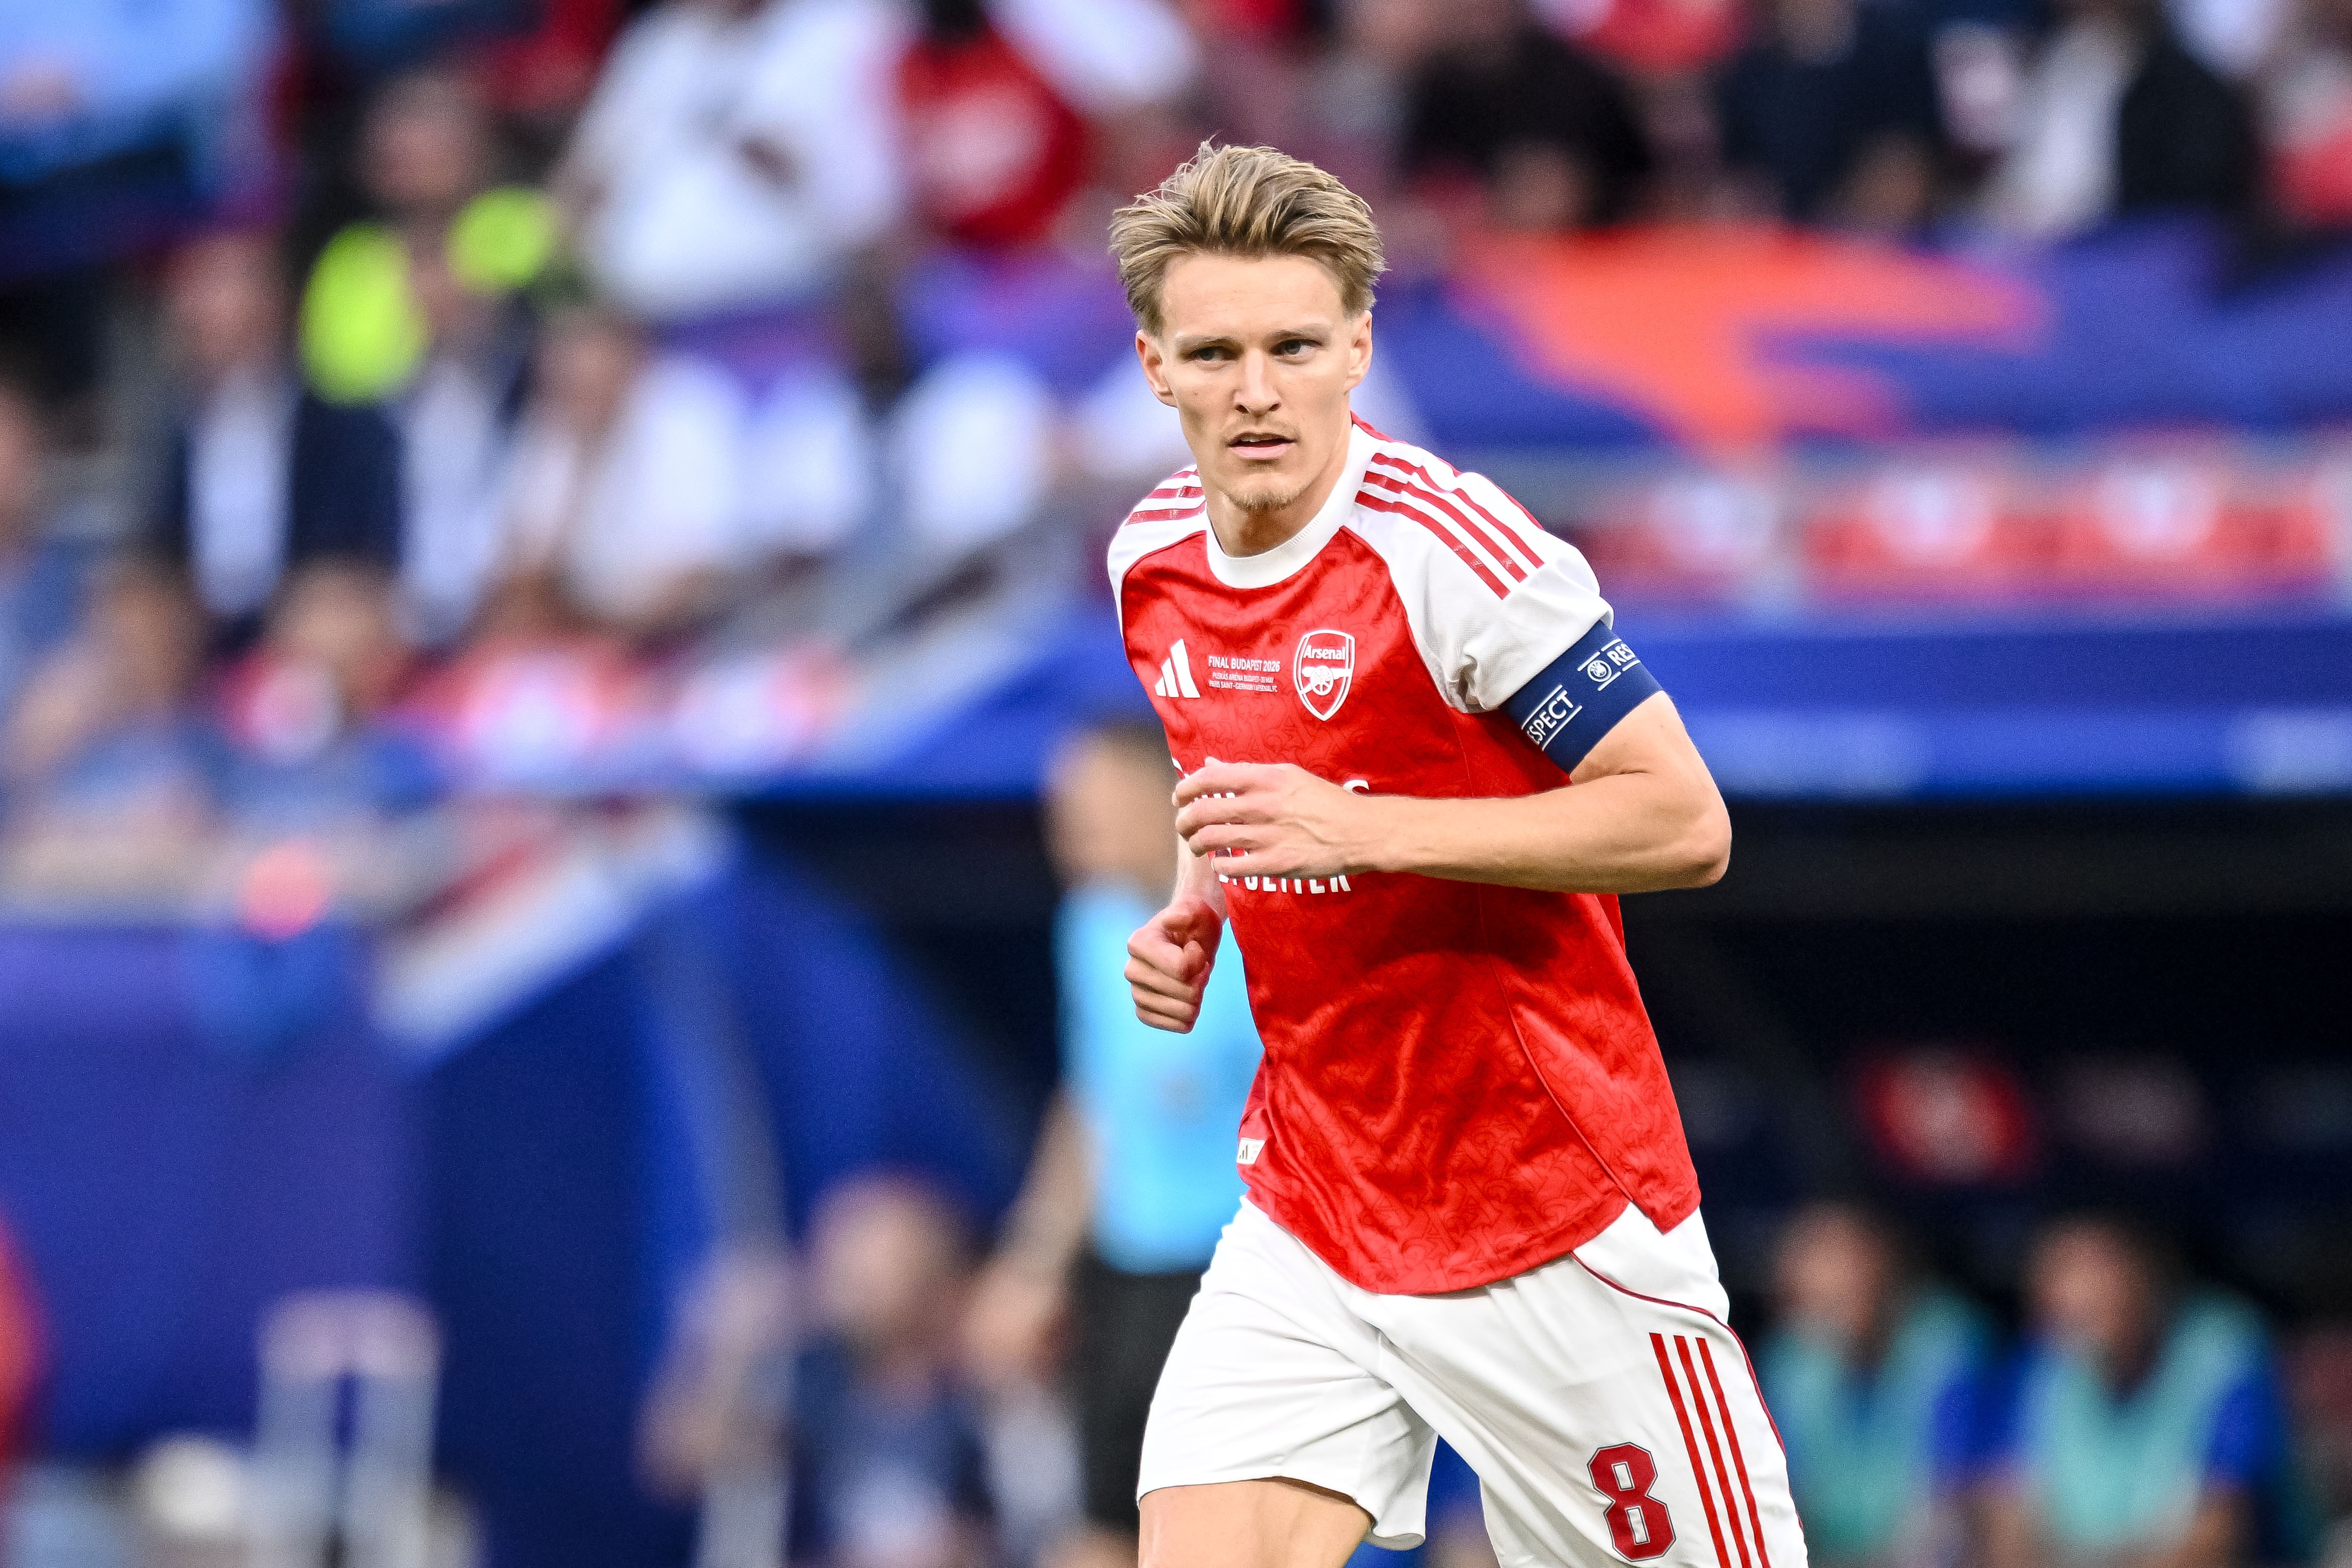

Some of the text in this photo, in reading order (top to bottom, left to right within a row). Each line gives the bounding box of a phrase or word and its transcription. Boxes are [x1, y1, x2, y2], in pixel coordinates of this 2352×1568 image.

[1303, 645, 1346, 660] Arsenal
[1209, 656, 1281, 672] FINAL BUDAPEST 2026
[1587, 1442, 1676, 1562] 8
